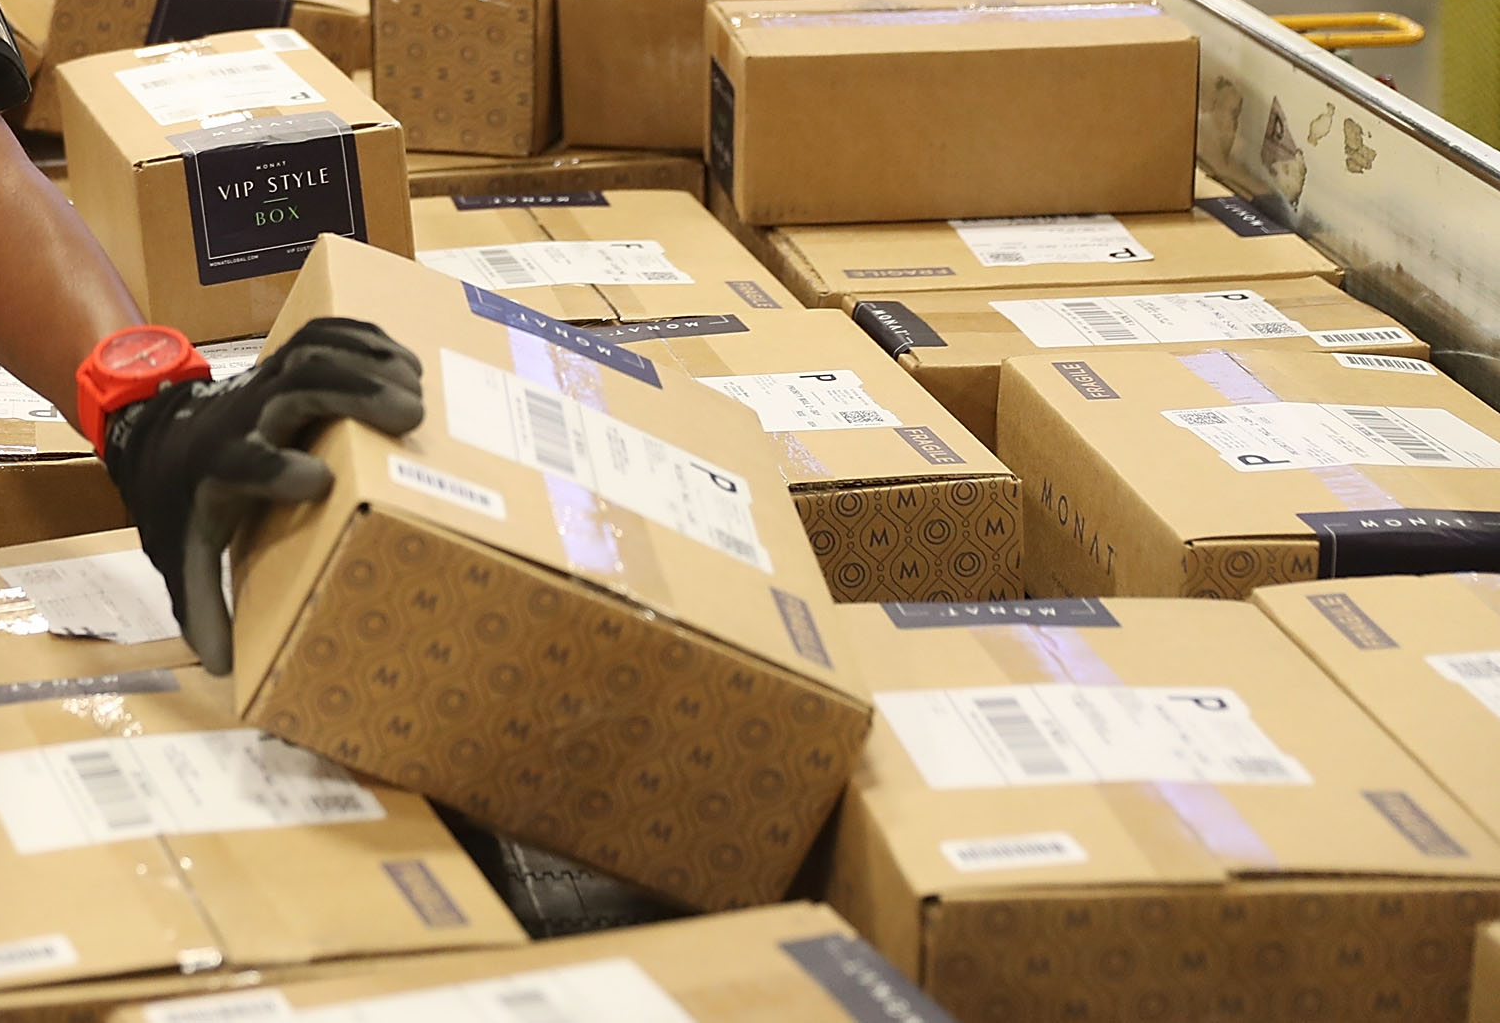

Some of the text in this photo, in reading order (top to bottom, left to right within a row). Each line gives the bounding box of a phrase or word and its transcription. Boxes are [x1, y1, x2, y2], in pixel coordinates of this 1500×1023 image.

[212, 119, 296, 137] MONAT
[255, 160, 287, 170] MONAT
[218, 167, 330, 201] VIP STYLE
[255, 206, 301, 226] BOX
[615, 321, 699, 336] MONAT
[873, 309, 908, 335] MONAT
[517, 312, 611, 356] MONAT
[799, 373, 837, 382] P
[1062, 363, 1111, 398] FRAGILE
[903, 428, 955, 463] FRAGILE
[1237, 454, 1291, 466] P
[690, 461, 738, 493] P
[1041, 478, 1115, 575] MONAT
[1360, 516, 1467, 528] MONAT
[1167, 695, 1228, 711] P
